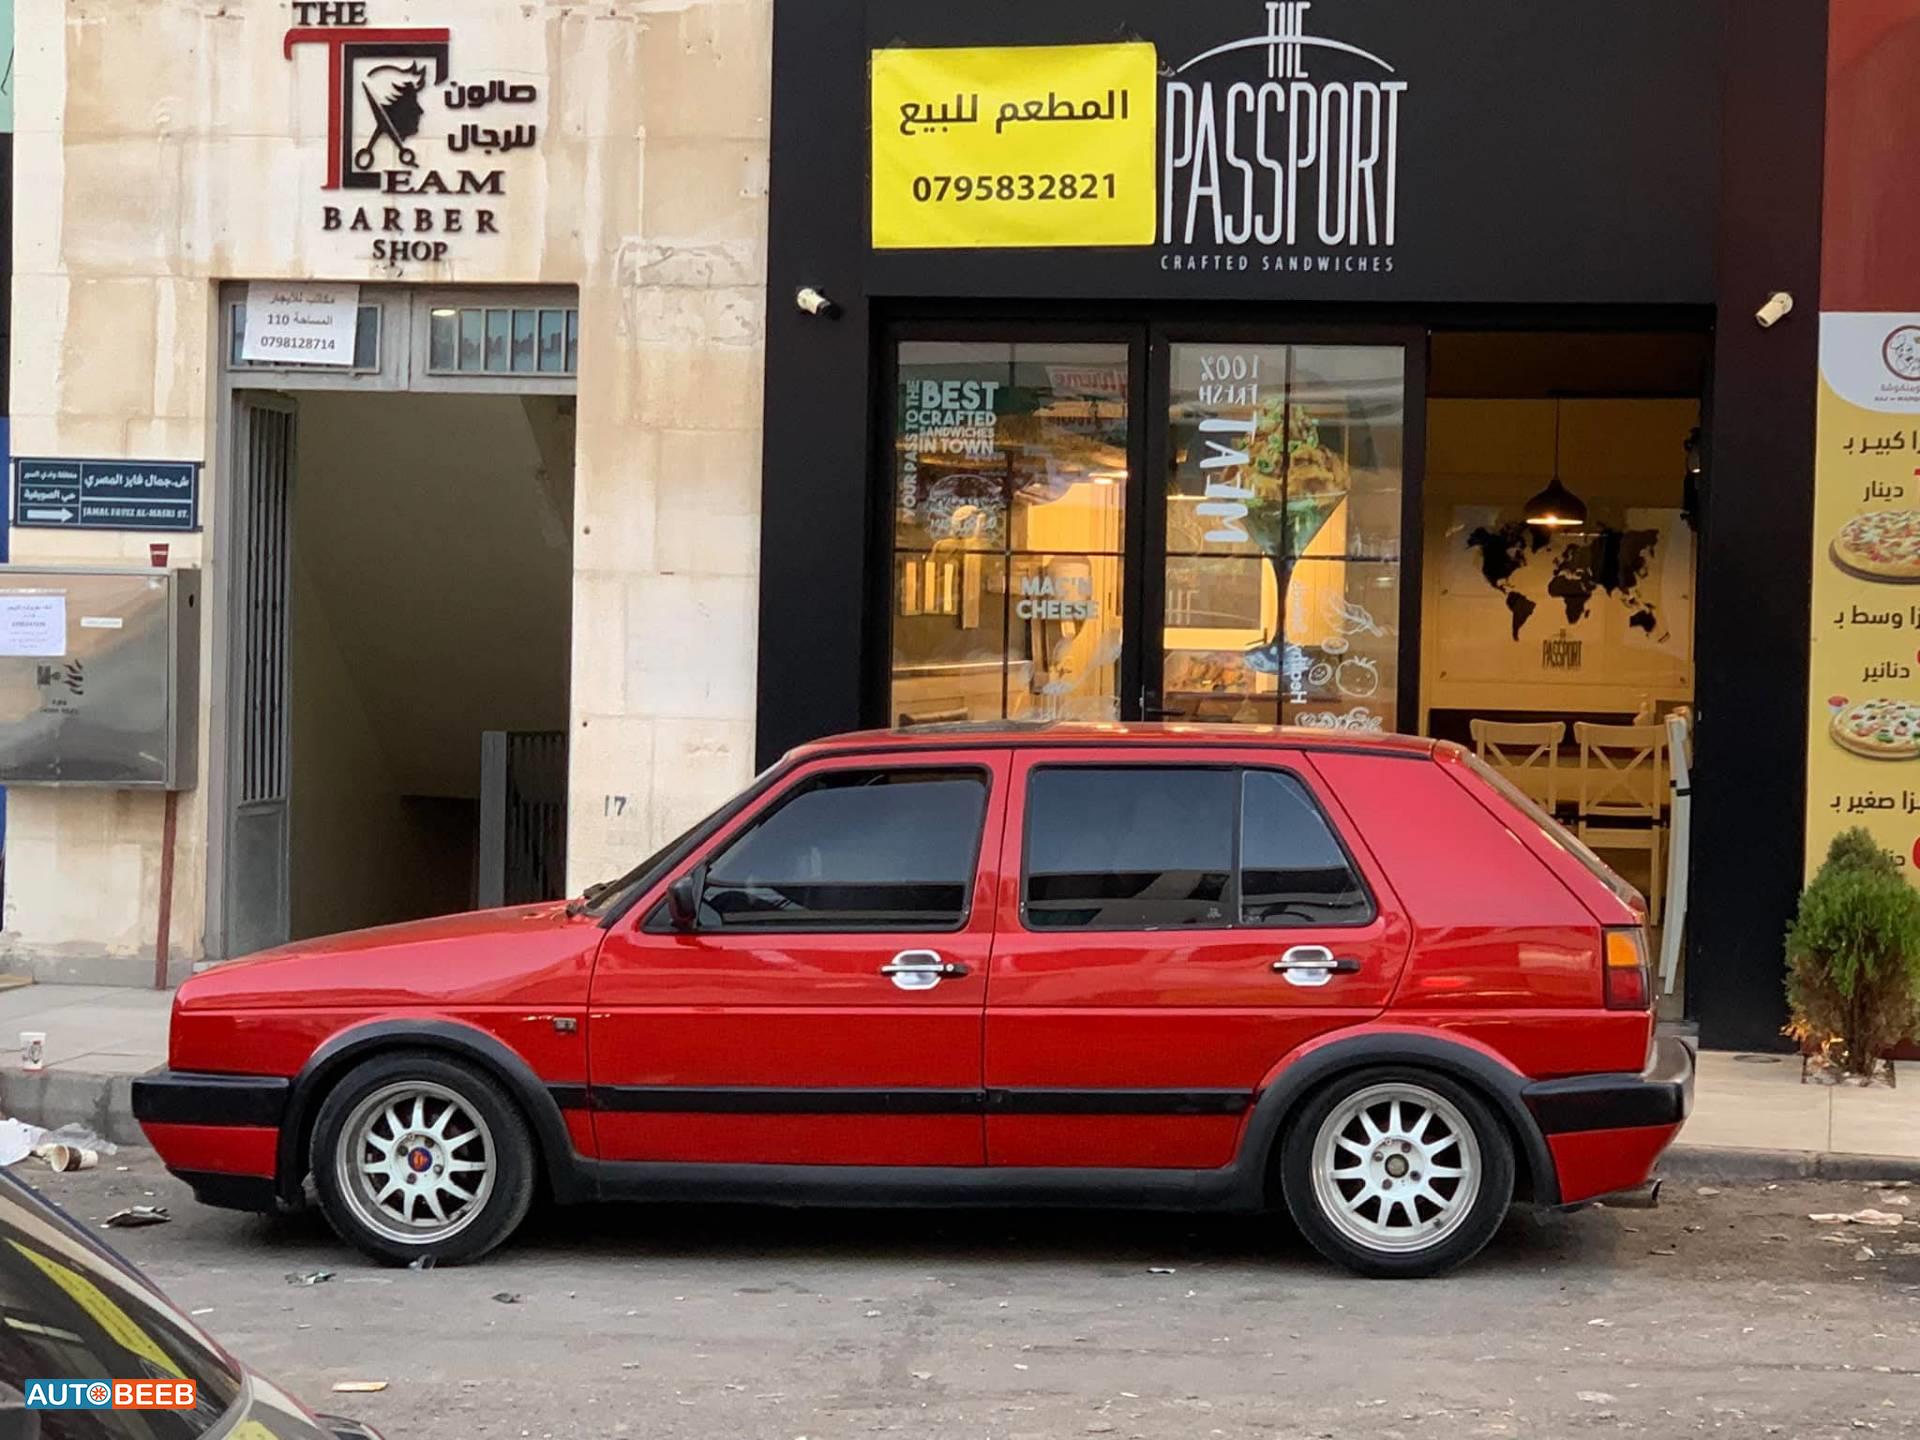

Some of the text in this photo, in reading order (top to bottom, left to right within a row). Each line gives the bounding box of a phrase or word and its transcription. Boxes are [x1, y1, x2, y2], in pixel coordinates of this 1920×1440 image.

[292, 1, 367, 26] THE
[1265, 2, 1311, 78] THE
[444, 80, 536, 109] صالون
[899, 90, 1128, 136] المطعم للبيع
[447, 124, 536, 154] للرجال
[1162, 81, 1408, 246] PASSPORT
[912, 173, 1116, 202] 0795832821
[322, 207, 499, 233] BARBER
[372, 240, 448, 261] SHOP
[1161, 255, 1394, 272] CRAFTED SANDWICHES
[267, 313, 290, 325] 110
[260, 335, 336, 351] 0798128714
[921, 380, 999, 410] BEST
[918, 411, 997, 426] CRAFTED
[919, 427, 994, 438] SANDWICHES
[1859, 430, 1905, 455] كبير
[902, 379, 920, 518] YOUR PASS TO THE
[919, 438, 994, 455] IN TOWN
[84, 473, 124, 489] المصري
[1863, 480, 1904, 502] دينار
[82, 506, 110, 517] JAMAL
[1016, 599, 1099, 620] CHEESE
[1851, 604, 1903, 629] وسط
[1543, 640, 1582, 668] PASSPORT
[1862, 661, 1910, 683] دنانير
[604, 795, 627, 816] 17
[1847, 790, 1895, 814] صغير
